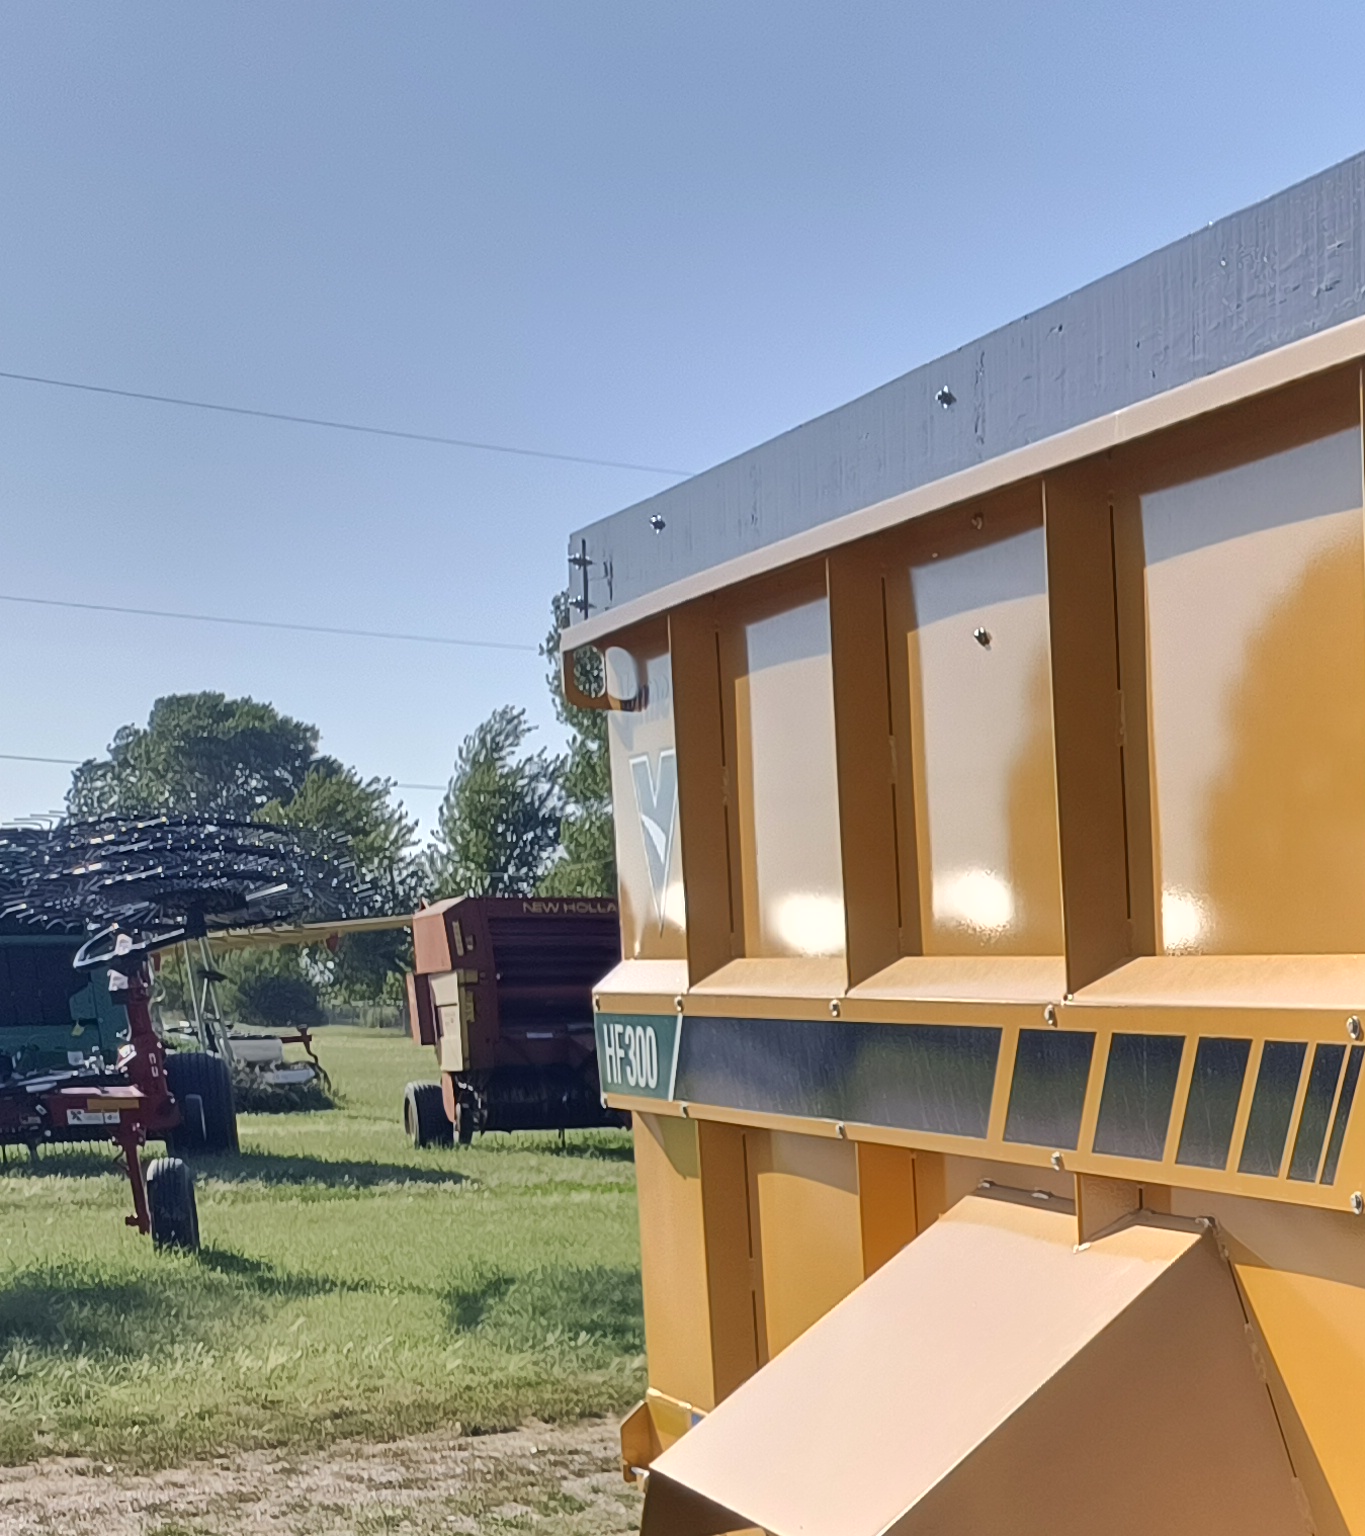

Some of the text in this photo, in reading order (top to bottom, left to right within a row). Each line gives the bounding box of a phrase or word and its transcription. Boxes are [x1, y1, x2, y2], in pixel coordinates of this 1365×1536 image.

[522, 901, 618, 914] NEW HOLLA
[602, 1023, 658, 1089] HF300
